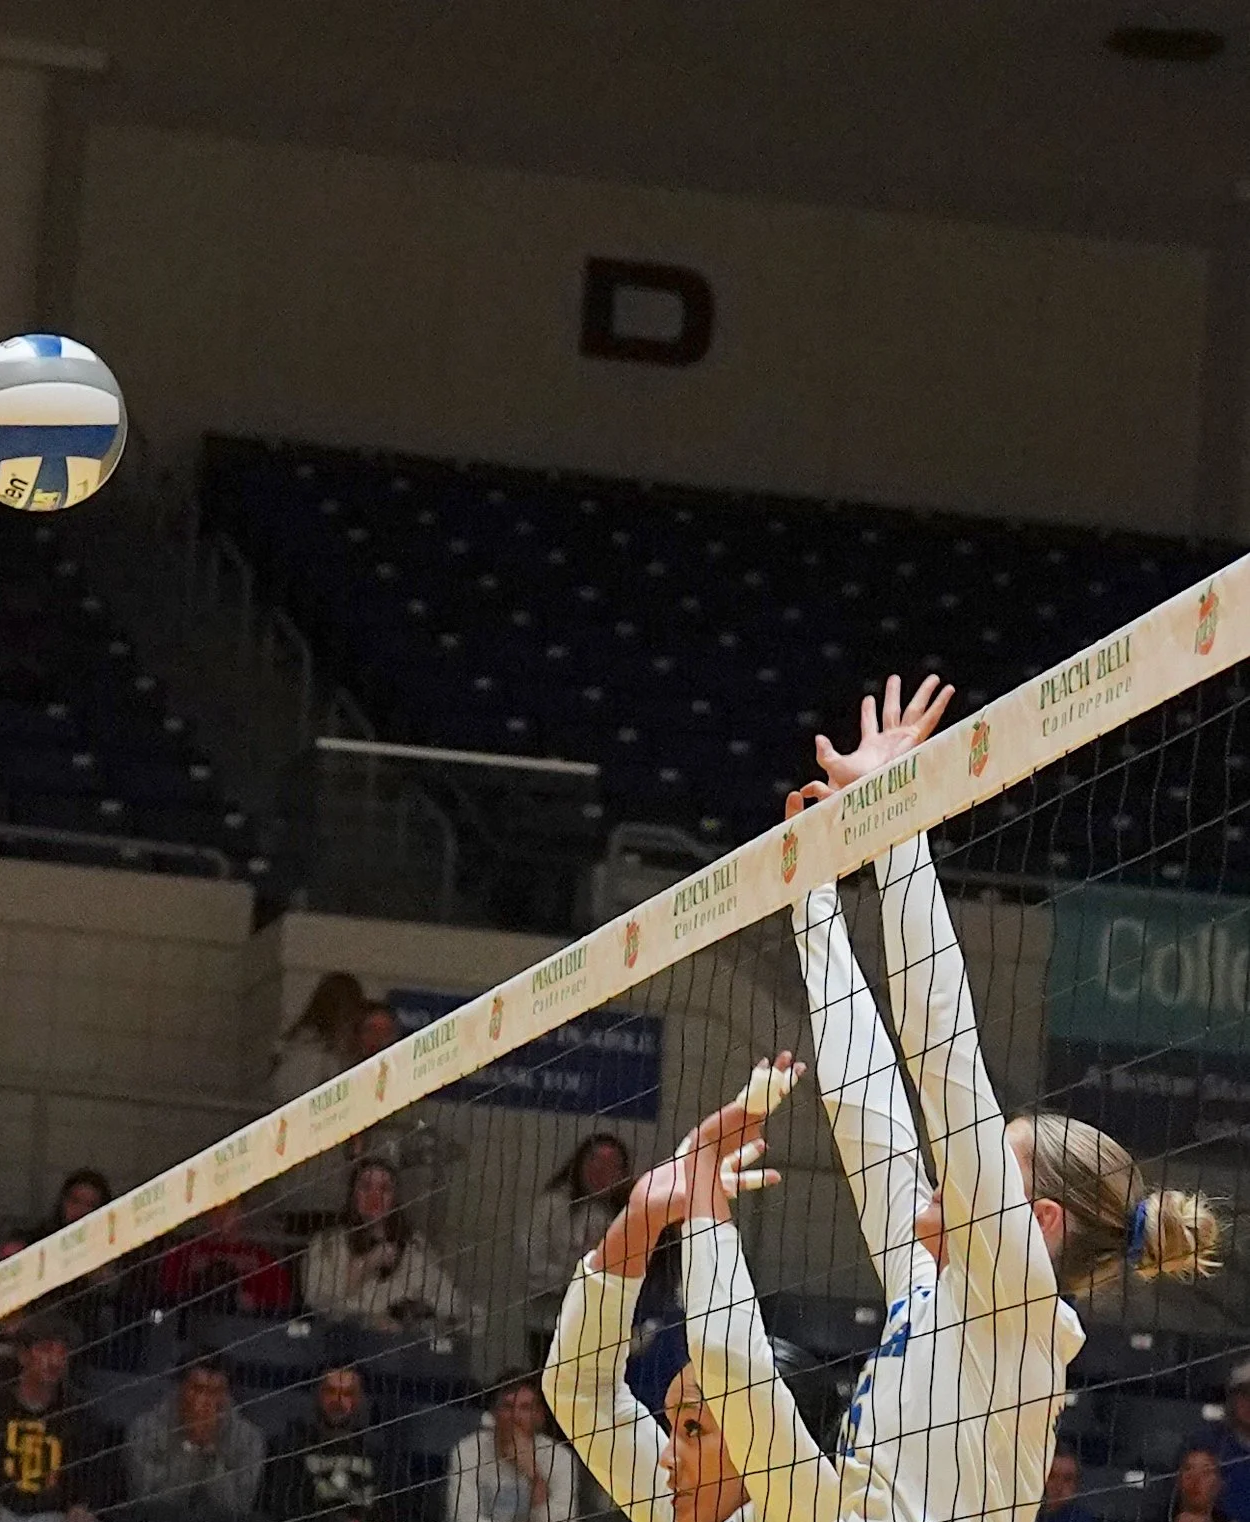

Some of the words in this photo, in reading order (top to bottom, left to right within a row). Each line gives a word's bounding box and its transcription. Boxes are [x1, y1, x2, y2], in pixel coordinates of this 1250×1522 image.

[580, 256, 714, 367] D
[1040, 657, 1090, 710] PEACH
[1097, 633, 1132, 680] BELT
